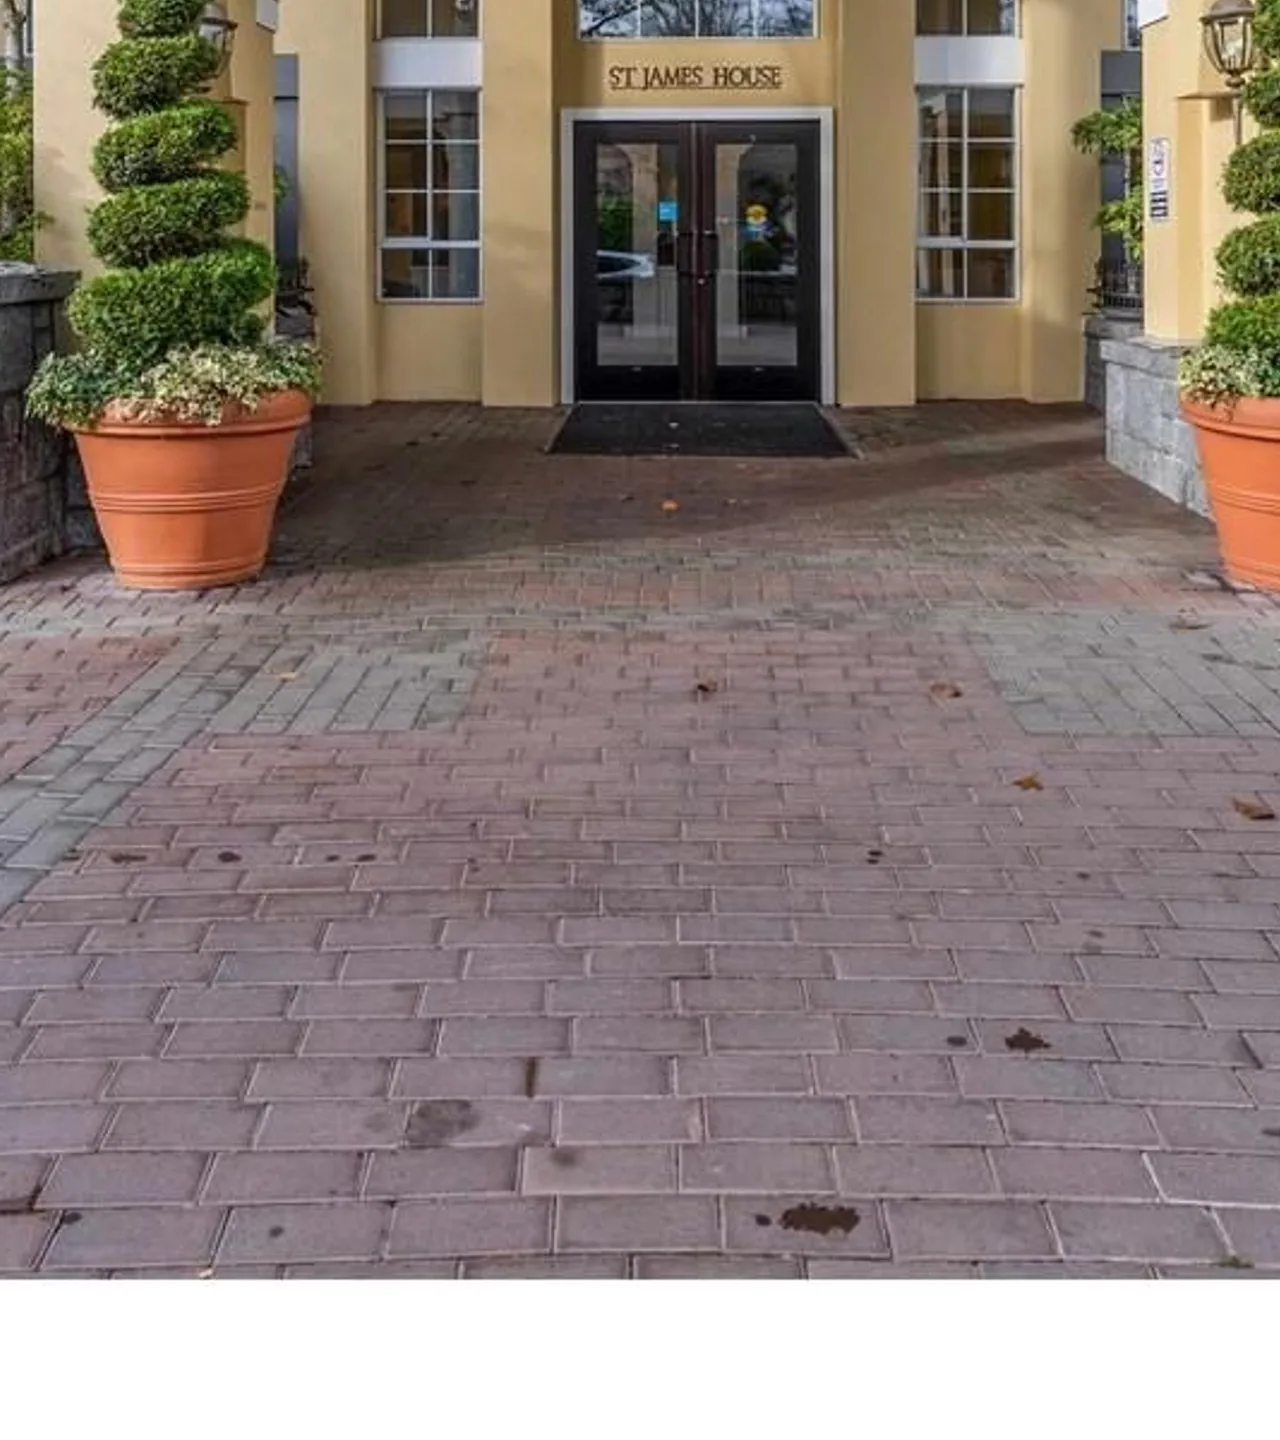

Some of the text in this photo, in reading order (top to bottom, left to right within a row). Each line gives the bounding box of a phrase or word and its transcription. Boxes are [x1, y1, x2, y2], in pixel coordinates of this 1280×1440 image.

[608, 65, 782, 90] ST JAMES HOUSE
